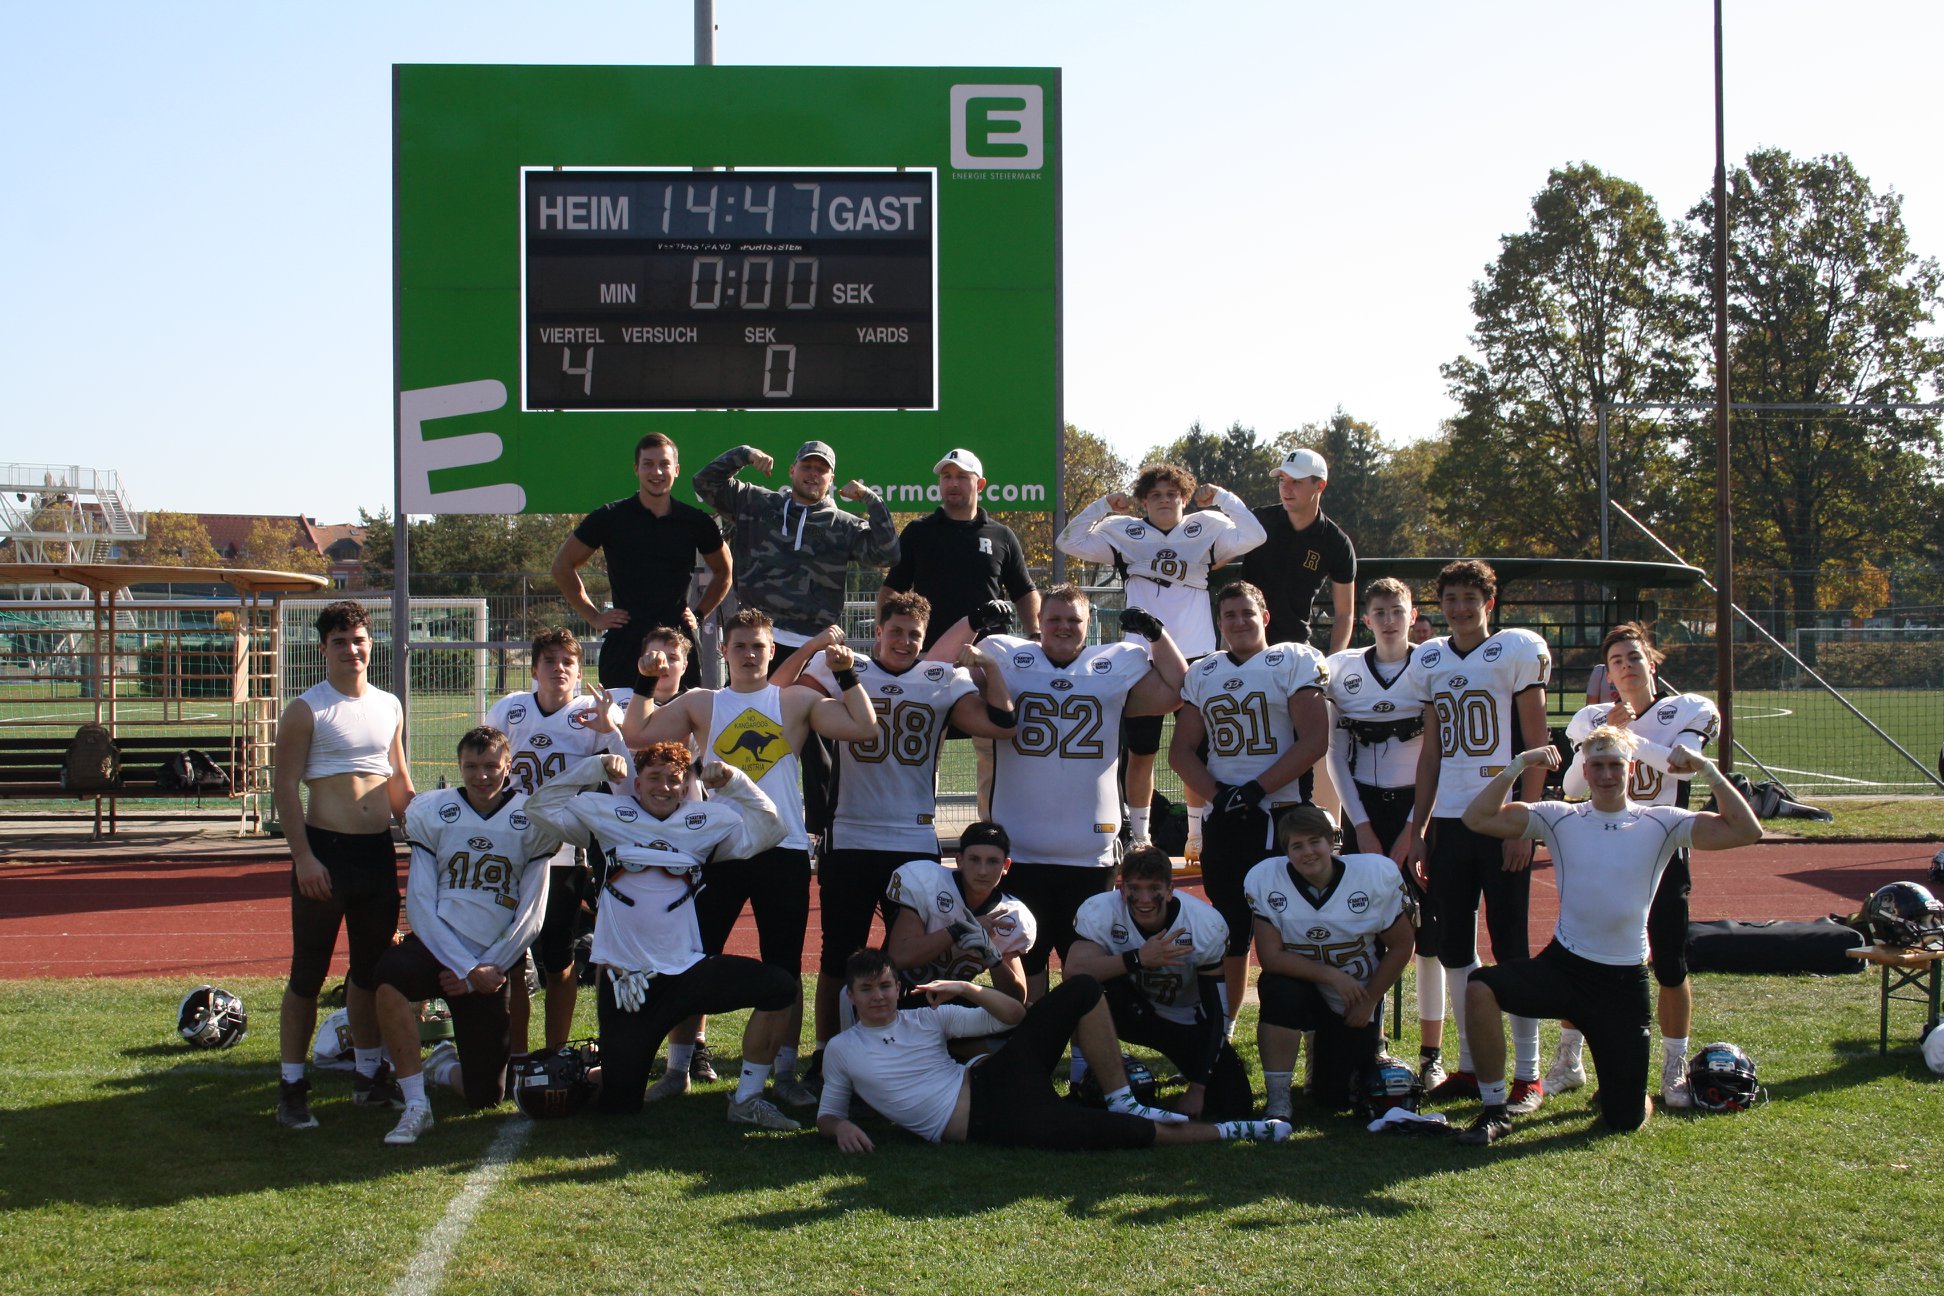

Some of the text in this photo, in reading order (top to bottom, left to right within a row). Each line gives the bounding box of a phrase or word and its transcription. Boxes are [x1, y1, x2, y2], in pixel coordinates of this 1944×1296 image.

[952, 172, 1042, 180] ENERGIE STEIERMARK
[538, 195, 629, 231] HEIM
[828, 196, 922, 231] GAST
[600, 256, 874, 309] MIN 0:00 SEK
[540, 327, 909, 344] VIERTEL VERSUCH SEK YARDS
[562, 344, 797, 398] 4 0
[979, 537, 993, 555] R
[1303, 549, 1321, 571] R
[734, 720, 769, 729] KANGAROOS
[849, 698, 936, 766] 58
[1012, 691, 1104, 759] 62
[1203, 692, 1278, 757] 61
[1434, 690, 1499, 757] 80
[741, 763, 765, 771] AUSTRIA
[1482, 767, 1488, 776] R
